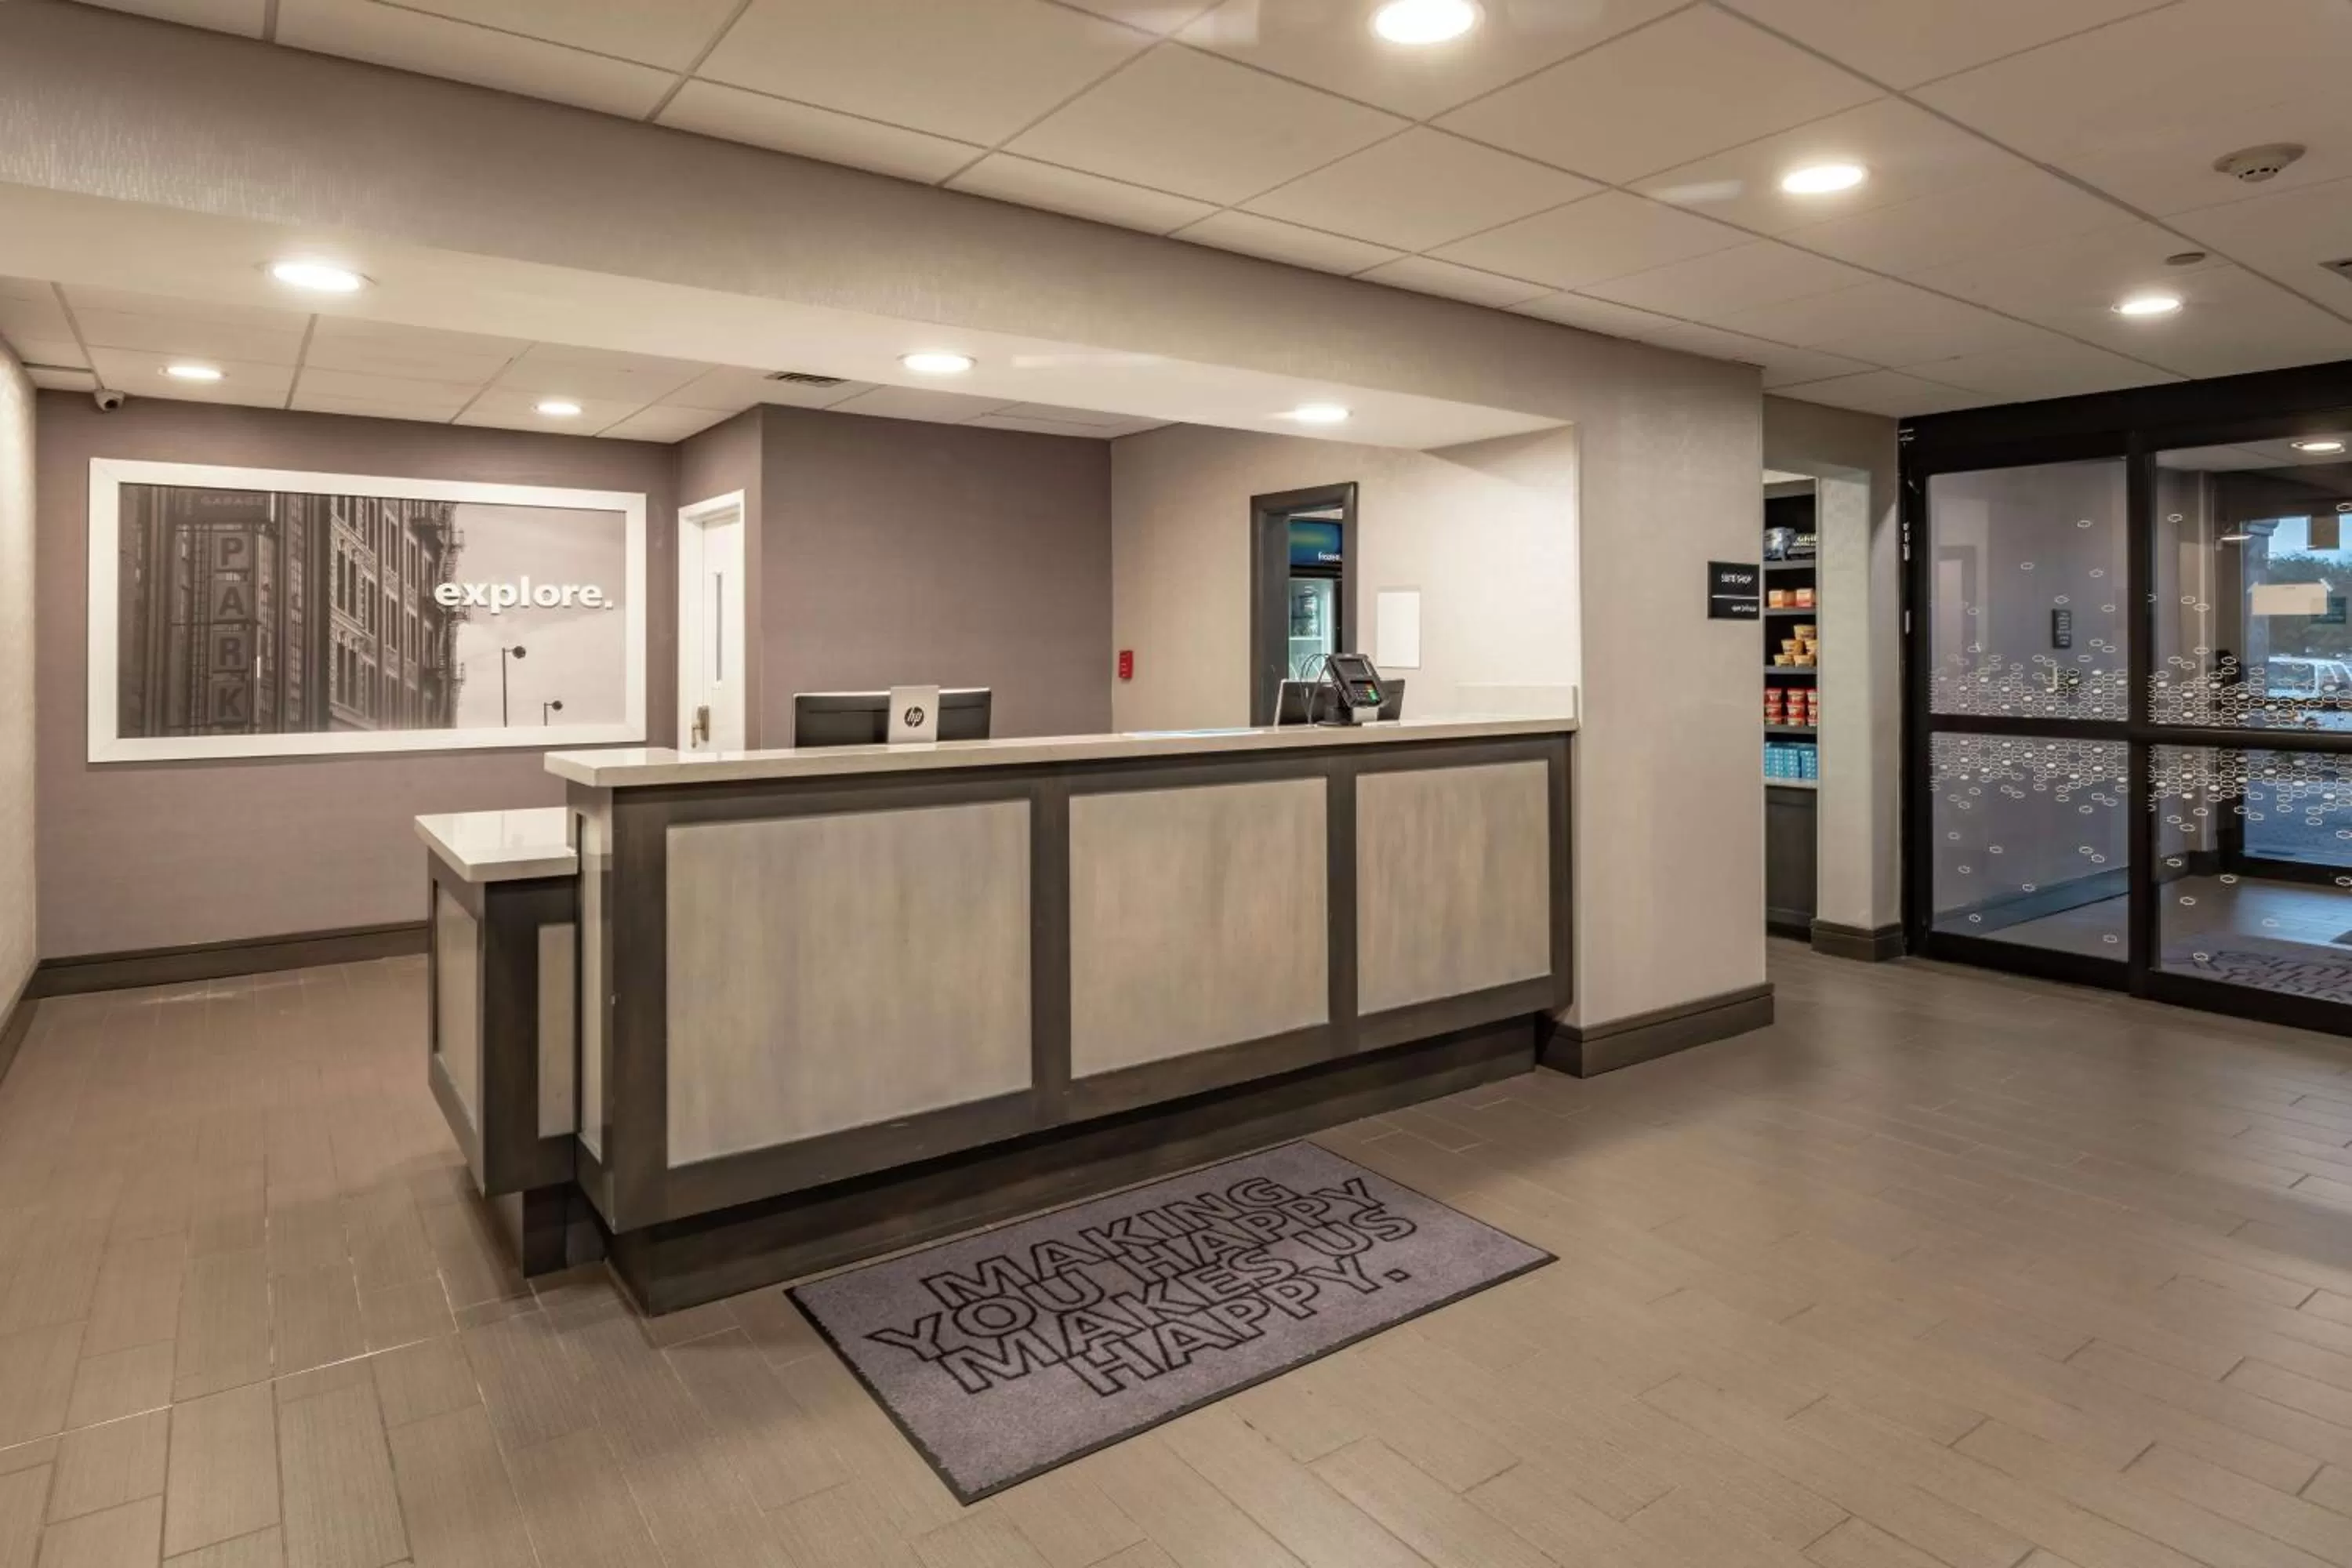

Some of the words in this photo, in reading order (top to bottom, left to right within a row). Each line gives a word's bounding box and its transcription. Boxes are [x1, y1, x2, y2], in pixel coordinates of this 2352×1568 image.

[216, 535, 245, 720] PARK
[434, 575, 613, 615] explore.
[905, 706, 924, 728] hp
[862, 1268, 1105, 1363] YOU
[1109, 1178, 1385, 1286] HAPPY
[920, 1177, 1301, 1310] MAKING
[936, 1245, 1299, 1395] MAKES
[1290, 1205, 1417, 1258] US
[1064, 1254, 1411, 1398] HAPPY.
